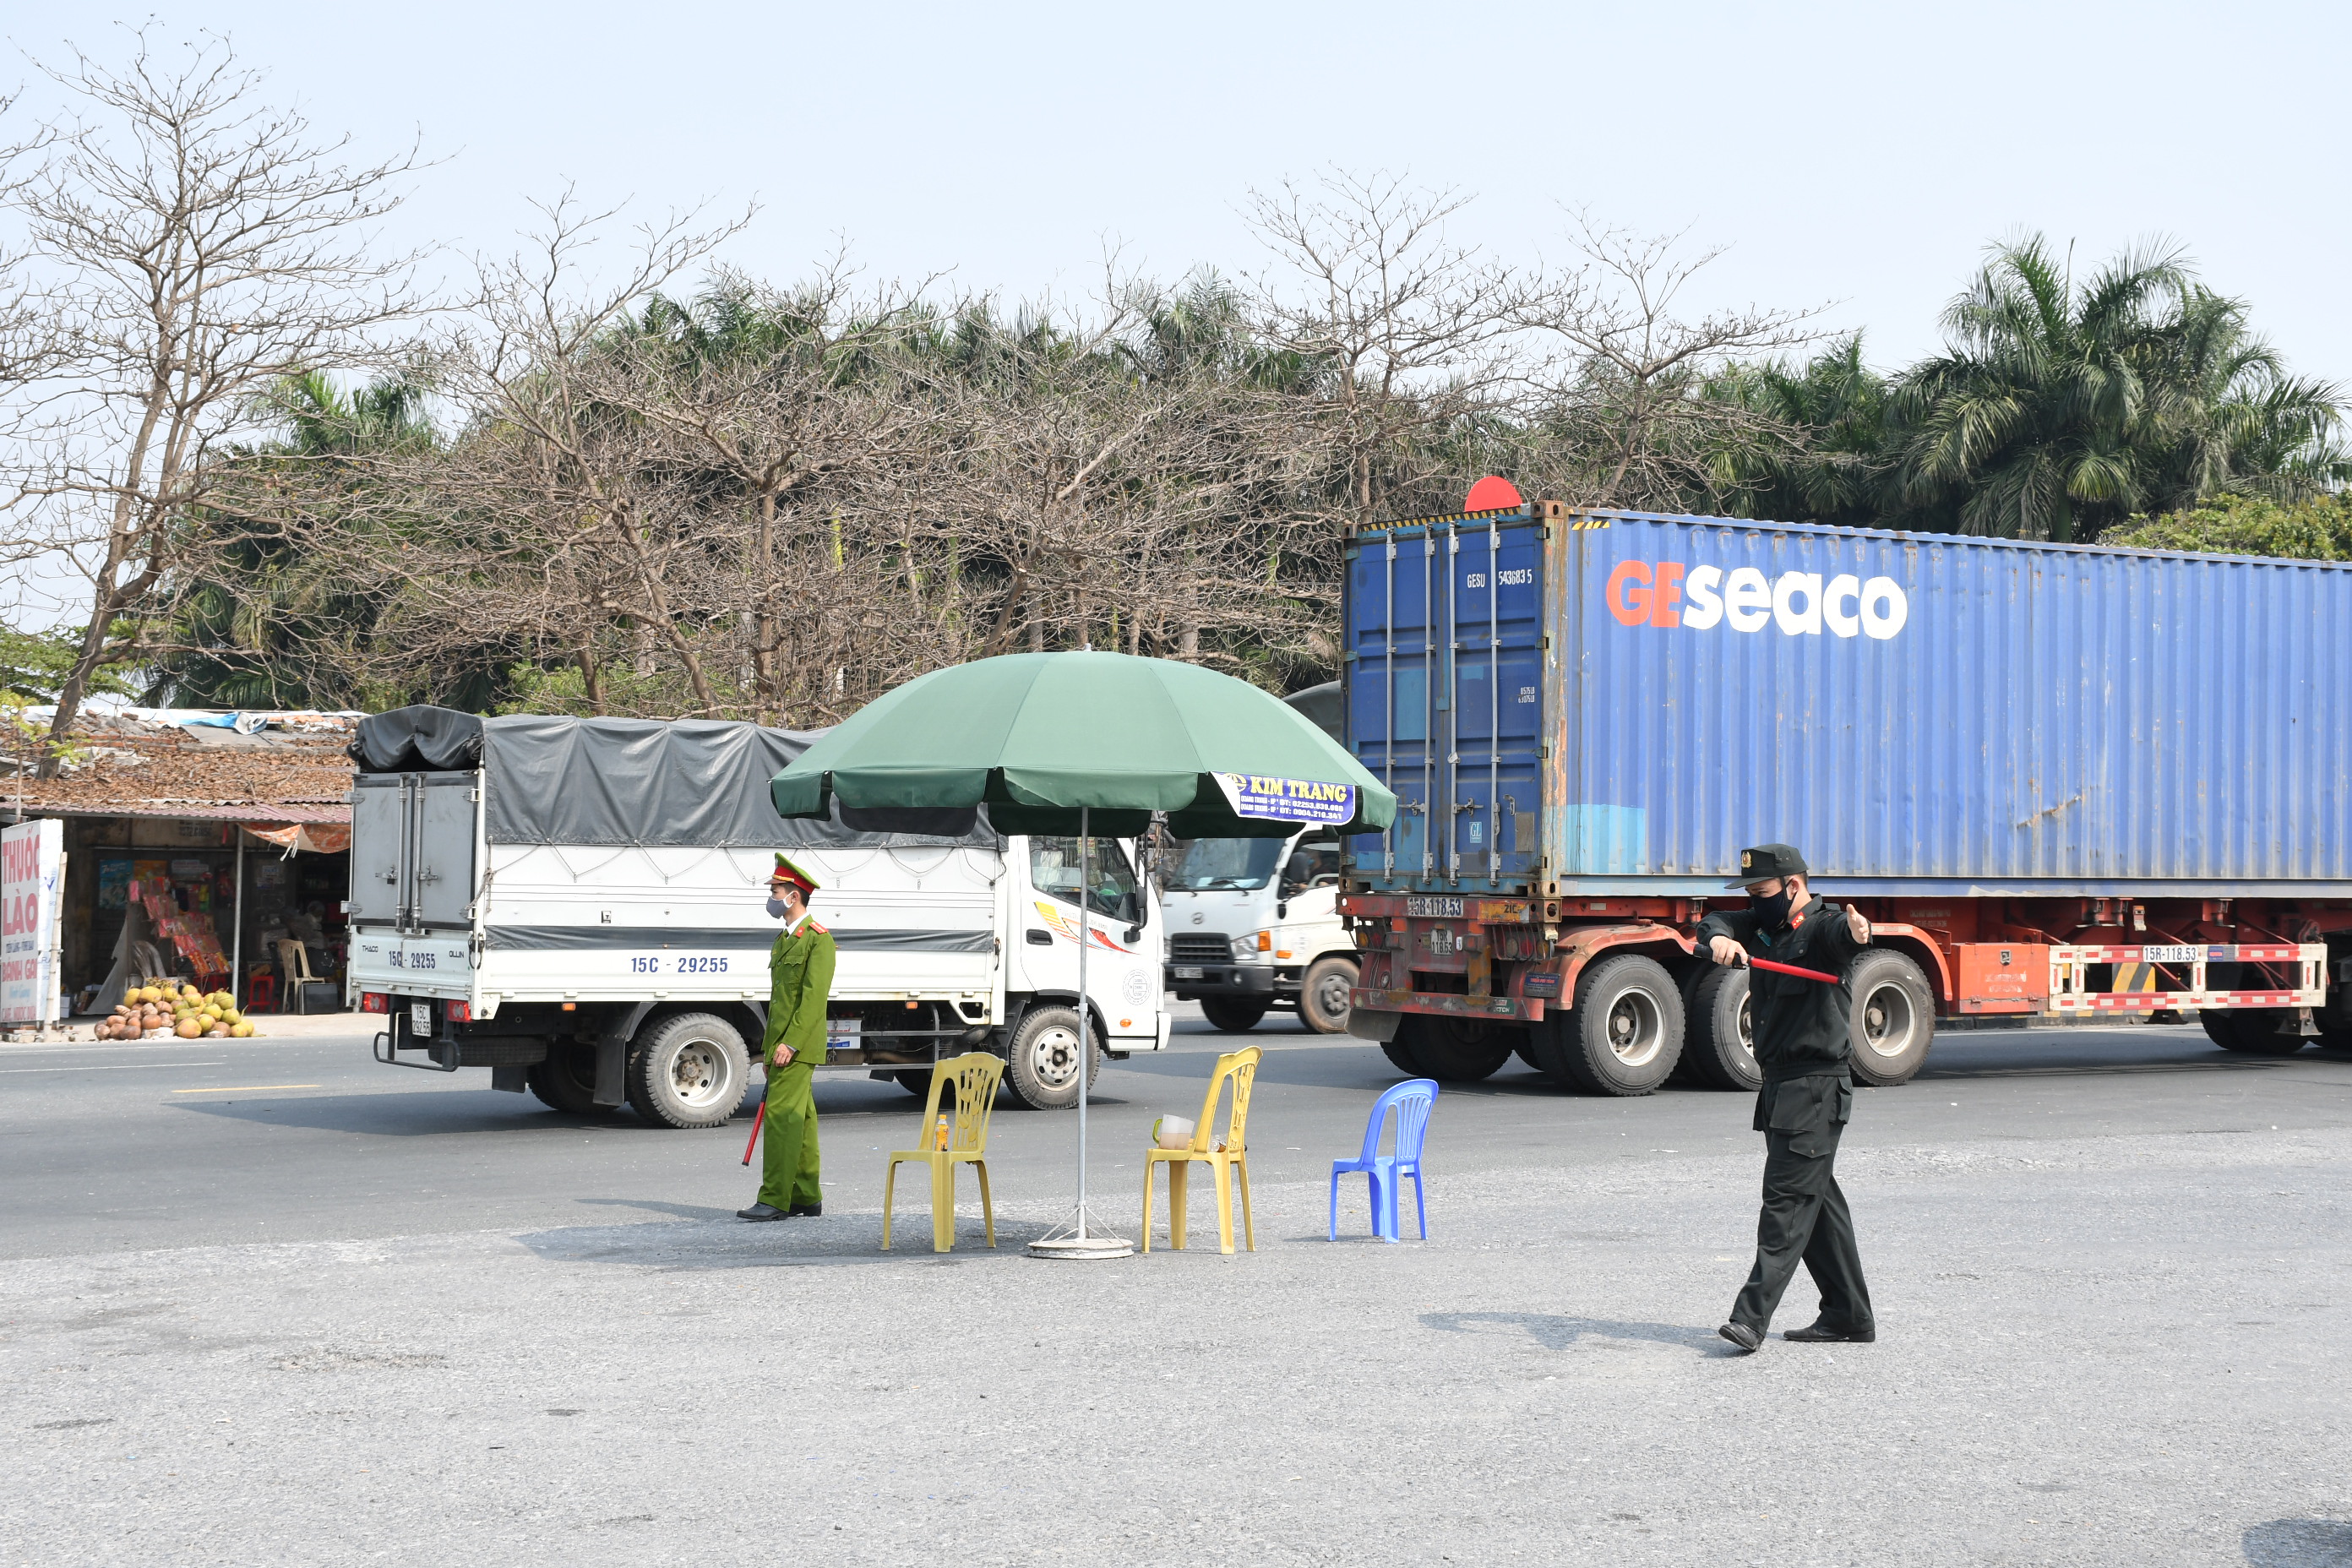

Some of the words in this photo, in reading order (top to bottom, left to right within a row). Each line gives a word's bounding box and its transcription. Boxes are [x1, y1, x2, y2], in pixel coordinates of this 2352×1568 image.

[1467, 573, 1486, 588] GESU
[1498, 569, 1526, 585] 543683
[1527, 569, 1533, 584] 5
[1250, 776, 1284, 797] KIM
[1287, 780, 1348, 803] TRANG
[1470, 823, 1481, 836] GL
[3, 826, 40, 885] THUỐC
[3, 889, 38, 936] LÀO
[1436, 930, 1448, 941] 15R
[362, 945, 379, 953] THACO
[449, 950, 465, 959] OLLIN
[2144, 946, 2197, 961] 15R-118.53
[389, 950, 403, 967] 15C
[411, 952, 436, 969] 29255
[631, 957, 659, 972] 15C
[678, 957, 728, 972] 29255
[415, 1005, 427, 1020] 15C
